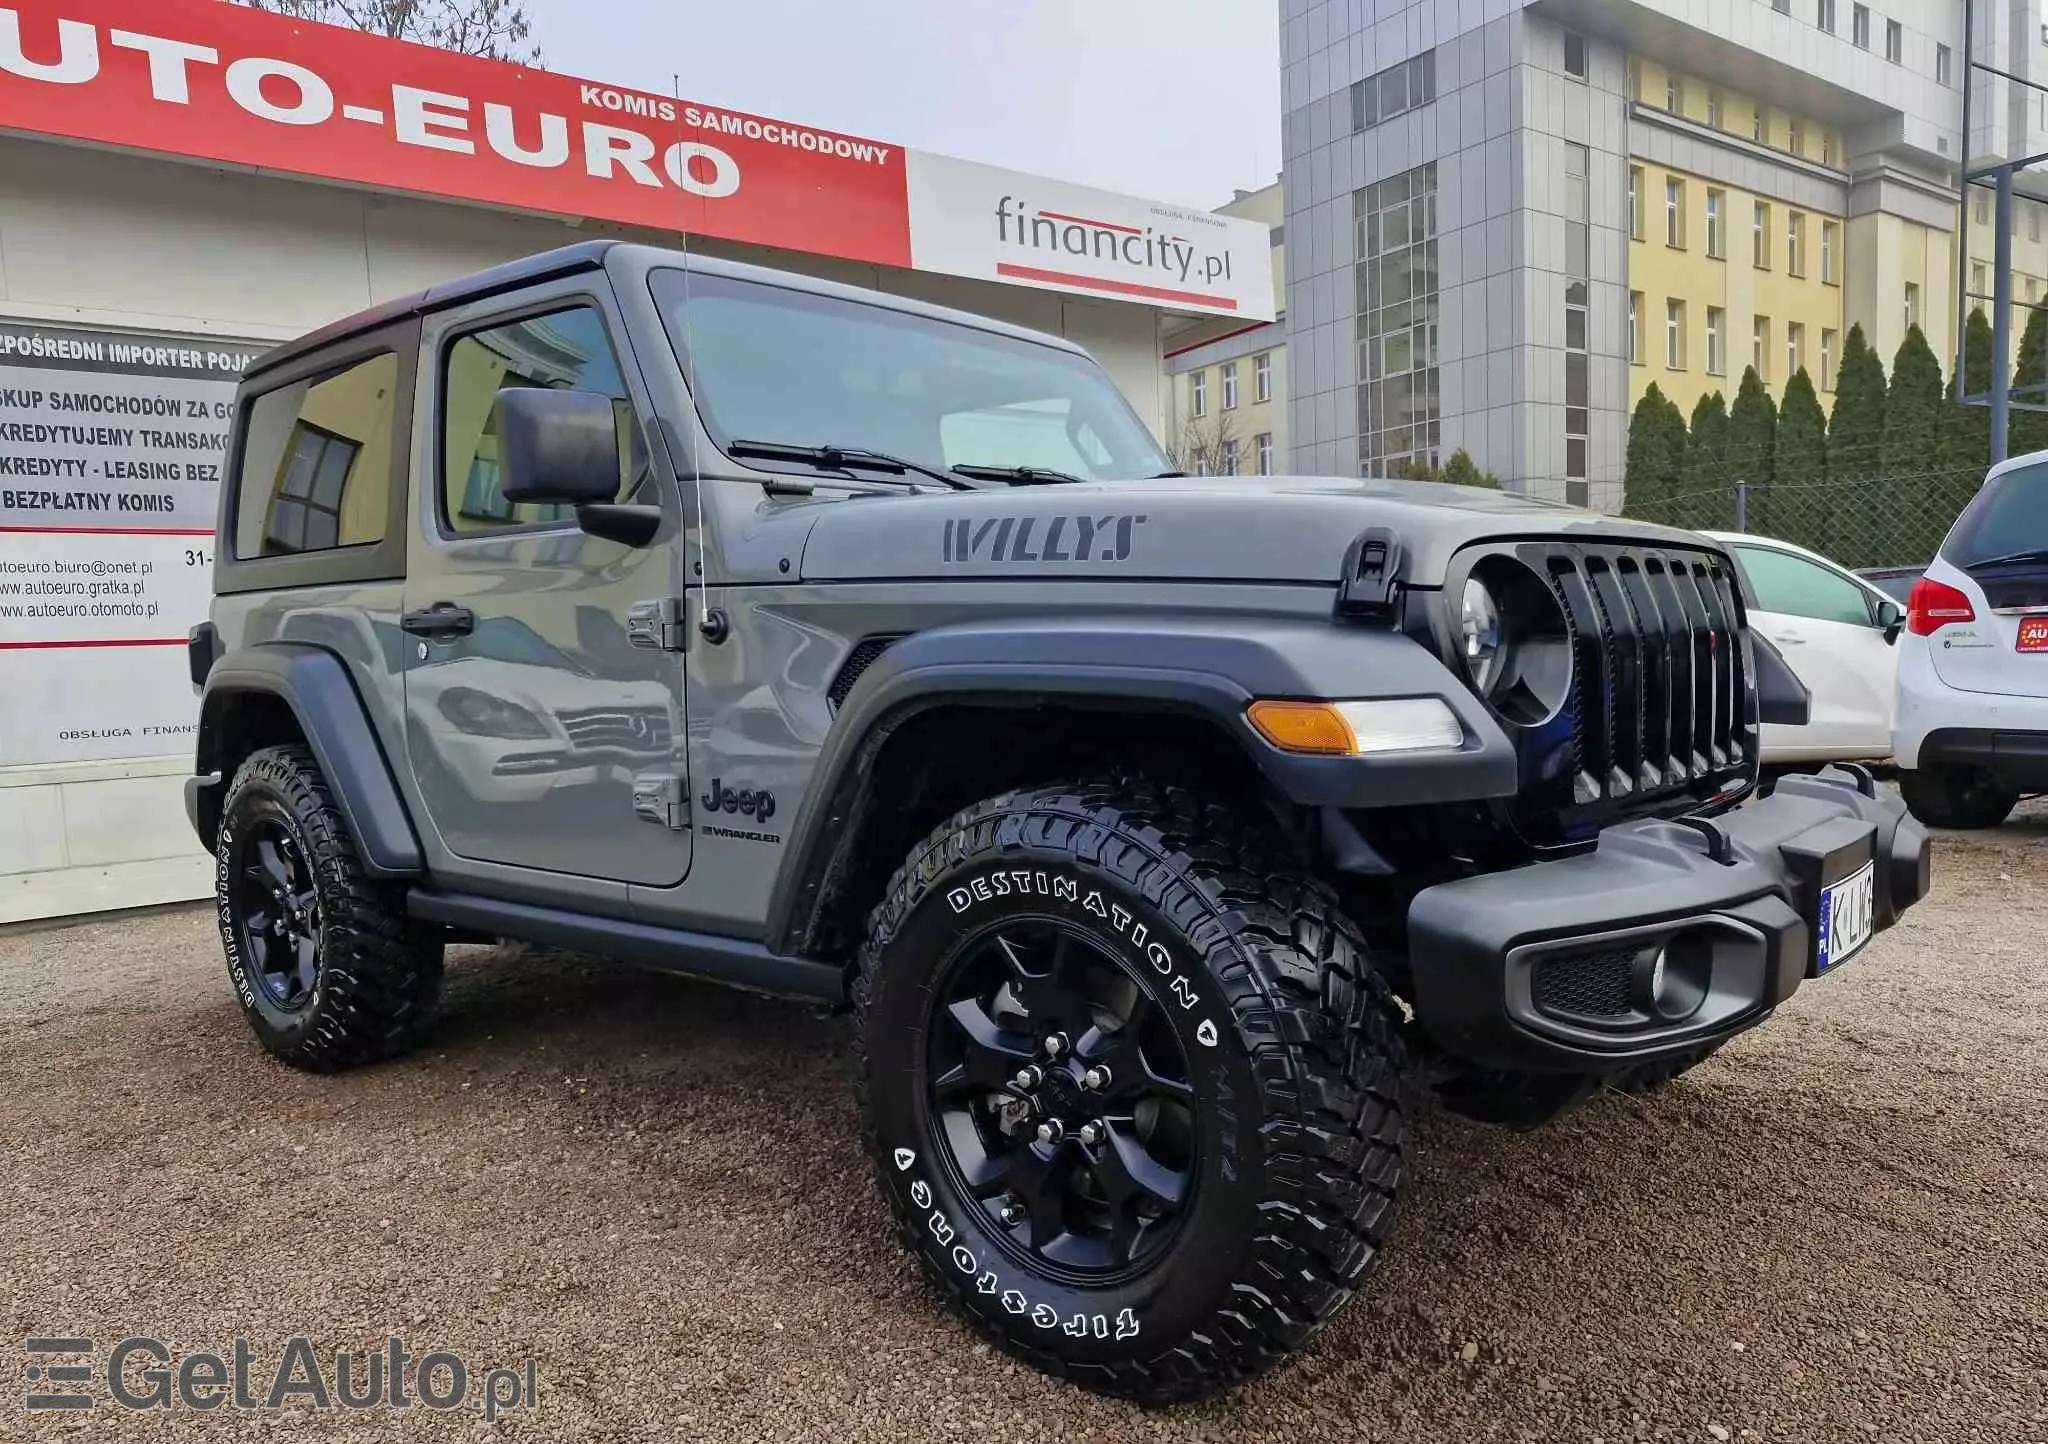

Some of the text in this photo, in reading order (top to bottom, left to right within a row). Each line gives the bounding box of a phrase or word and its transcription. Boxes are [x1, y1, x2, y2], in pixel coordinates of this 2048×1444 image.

[580, 84, 889, 165] KOMIS SAMOCHODOWY
[995, 196, 1231, 285] financity.pl
[109, 344, 202, 368] IMPORTER
[207, 350, 259, 372] POJA
[0, 388, 43, 409] KUP
[50, 391, 181, 418] SAMOCHODÓW
[186, 400, 209, 419] ZA
[0, 423, 133, 447] KREDYTUJEMY
[0, 456, 87, 477] KREDYTY
[104, 461, 181, 481] LEASING
[186, 463, 219, 482] BEZ
[3, 490, 175, 512] BEZPŁATNY KOMIS
[943, 515, 1148, 562] WILLYS
[0, 560, 153, 577] toeuro.biuro@onet.pl
[59, 728, 132, 740] OBSŁUGA
[701, 778, 776, 824] Jeep
[713, 827, 780, 844] WRANGLER
[219, 846, 255, 1008] DESTINATION
[947, 872, 1201, 1010] DESTINATION
[911, 1180, 1140, 1341] Firestone
